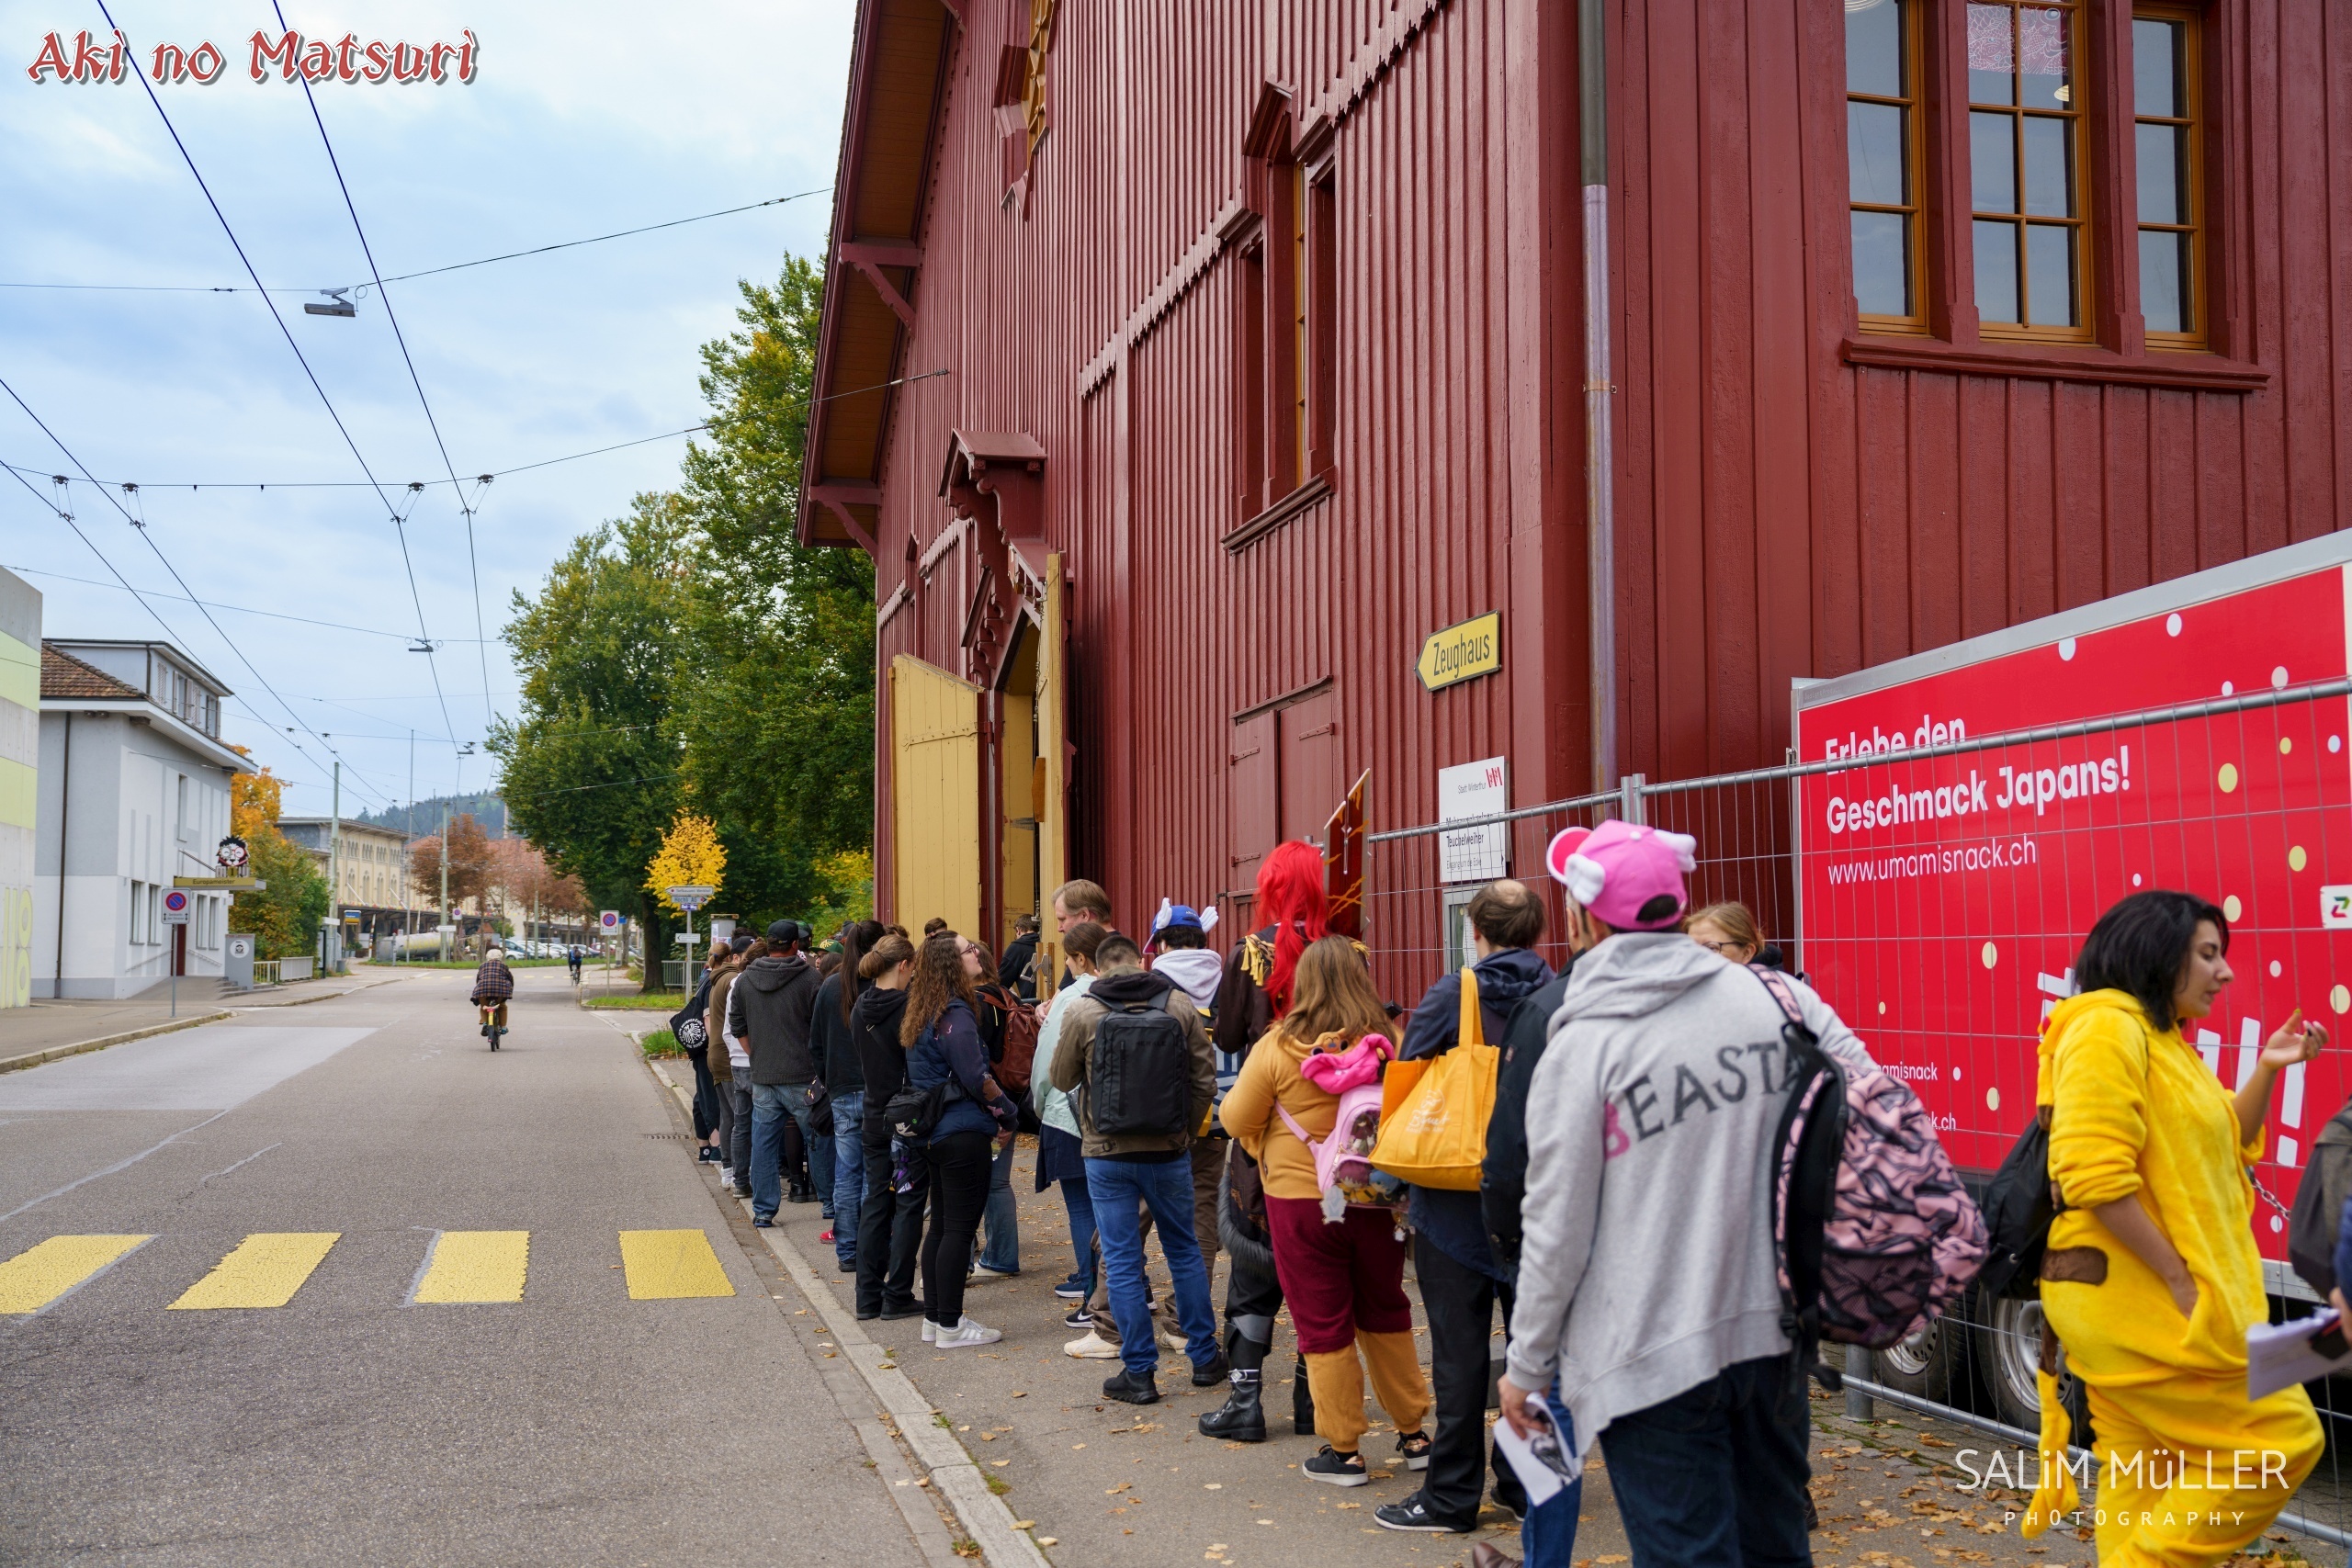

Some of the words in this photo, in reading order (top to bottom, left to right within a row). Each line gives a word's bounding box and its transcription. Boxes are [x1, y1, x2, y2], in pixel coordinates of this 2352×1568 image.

[1433, 633, 1490, 680] Zeughaus
[1914, 714, 1965, 748] den
[1457, 784, 1468, 794] Stadt
[1468, 781, 1487, 791] Winterthur
[1826, 769, 1989, 834] Geschmack
[1996, 745, 2131, 816] Japans!
[1827, 832, 2037, 885] www.umamisnack.ch
